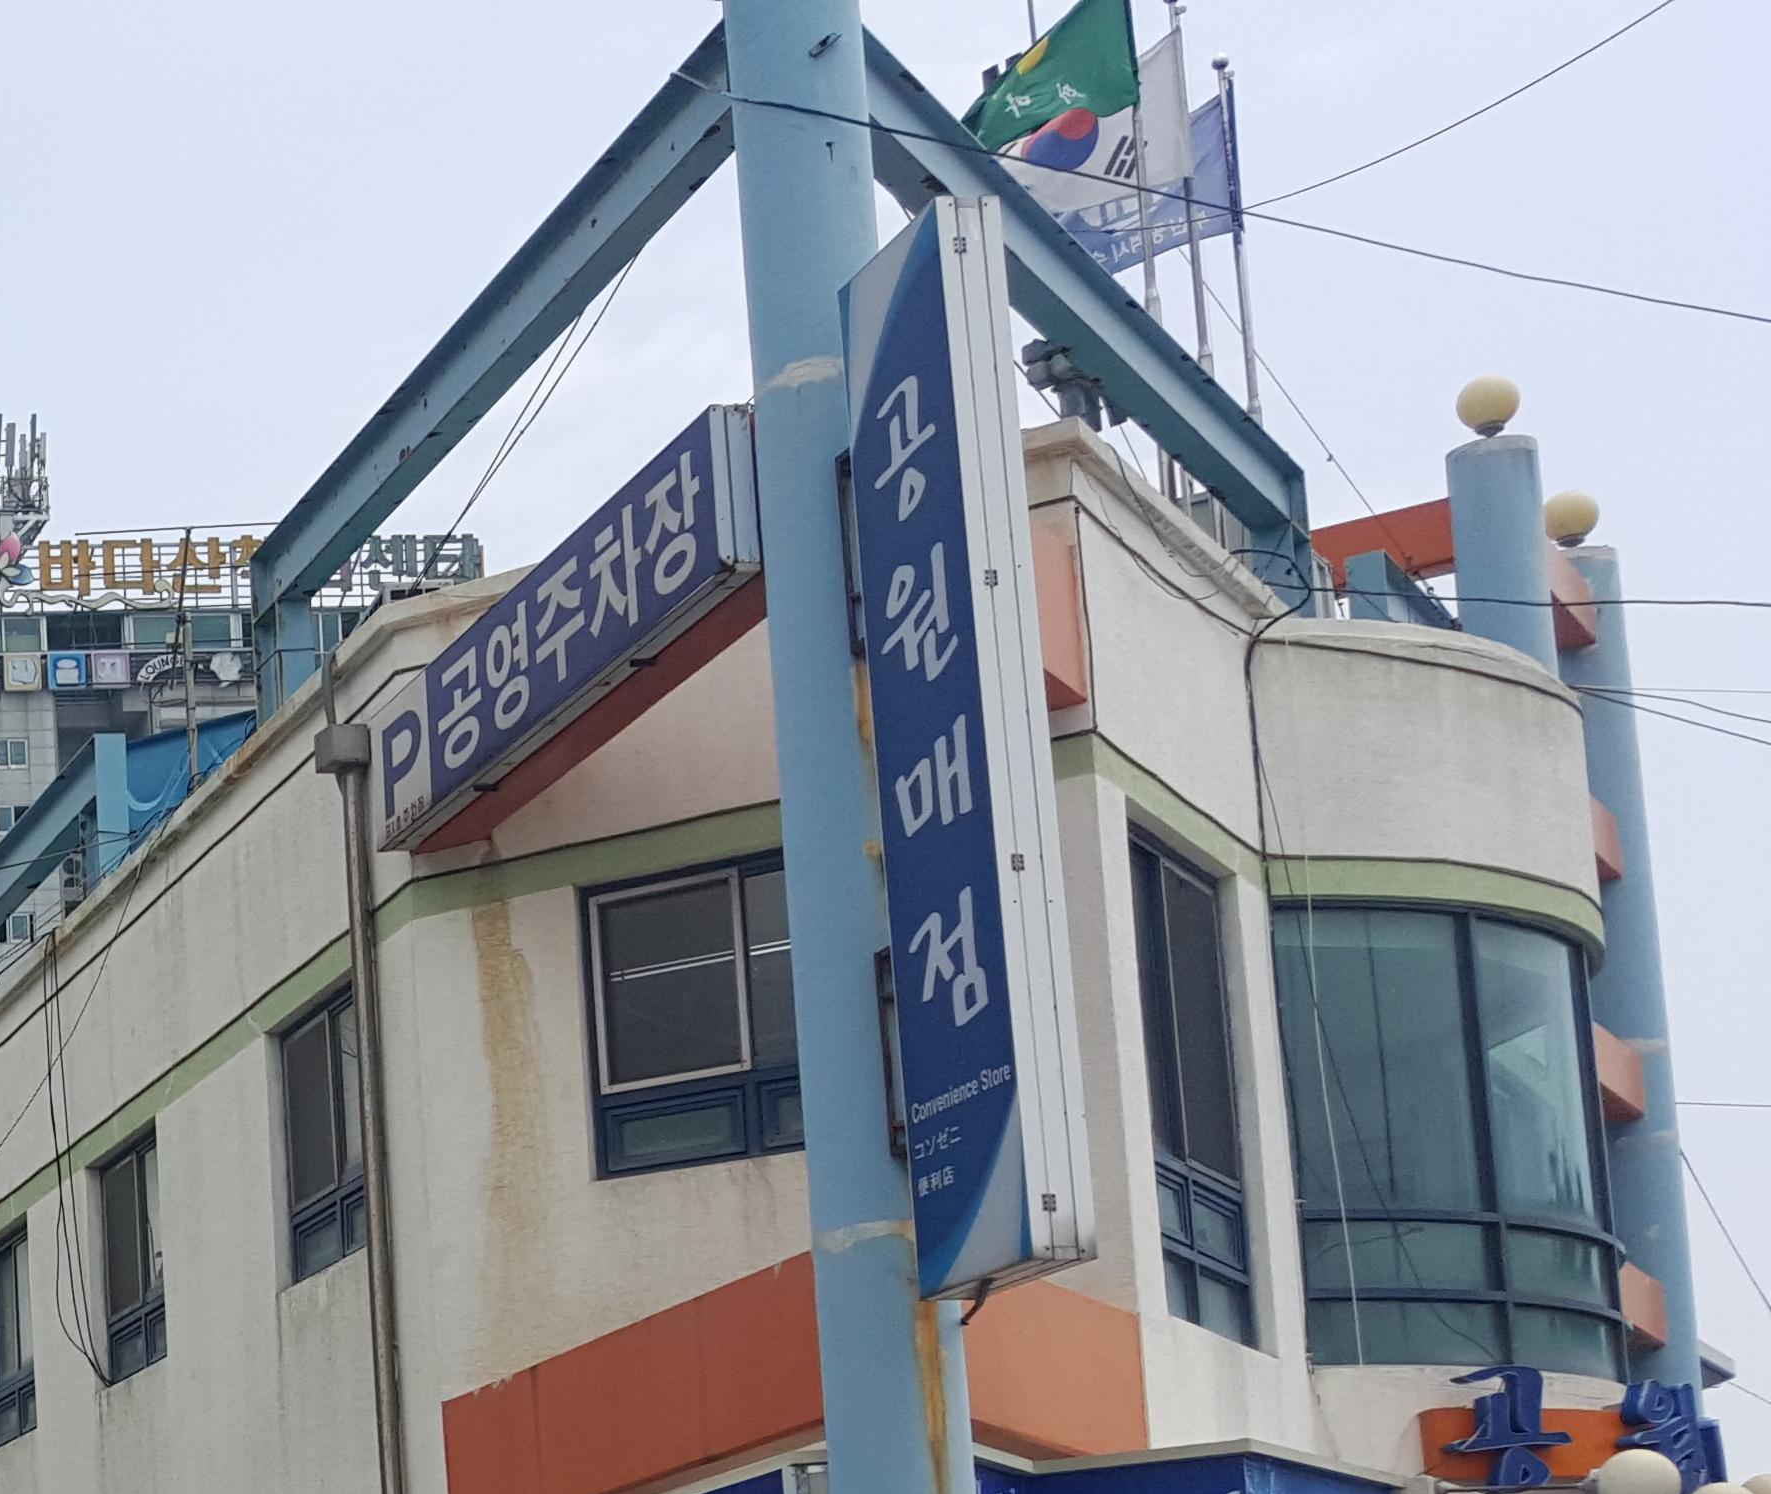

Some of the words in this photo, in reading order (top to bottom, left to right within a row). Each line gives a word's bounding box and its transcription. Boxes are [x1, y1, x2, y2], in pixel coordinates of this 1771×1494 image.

[382, 707, 424, 821] P
[435, 450, 702, 773] 공영주차장
[873, 375, 991, 1028] 공원매점
[910, 1075, 980, 1126] Convenience
[979, 1062, 1012, 1093] Store
[917, 1164, 955, 1199] 便利店
